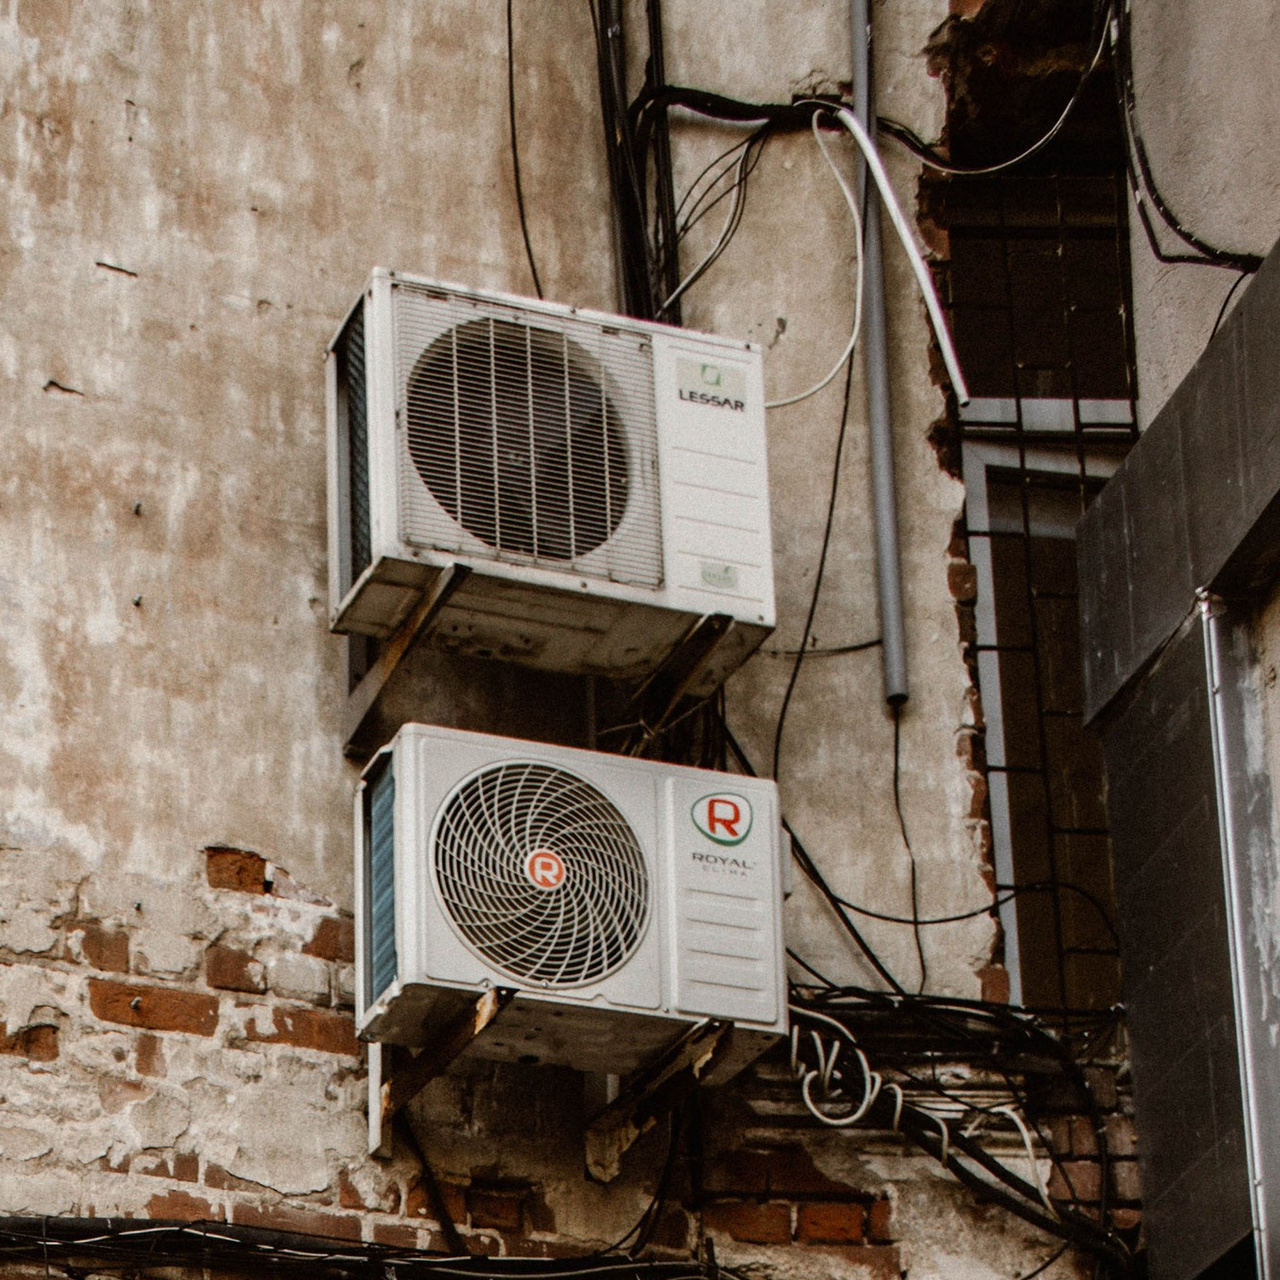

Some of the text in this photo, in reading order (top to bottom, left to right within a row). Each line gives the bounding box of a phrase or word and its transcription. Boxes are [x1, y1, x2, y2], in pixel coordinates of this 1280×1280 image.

[679, 389, 745, 412] LESSAR
[708, 799, 741, 837] R
[692, 852, 752, 870] ROYAL
